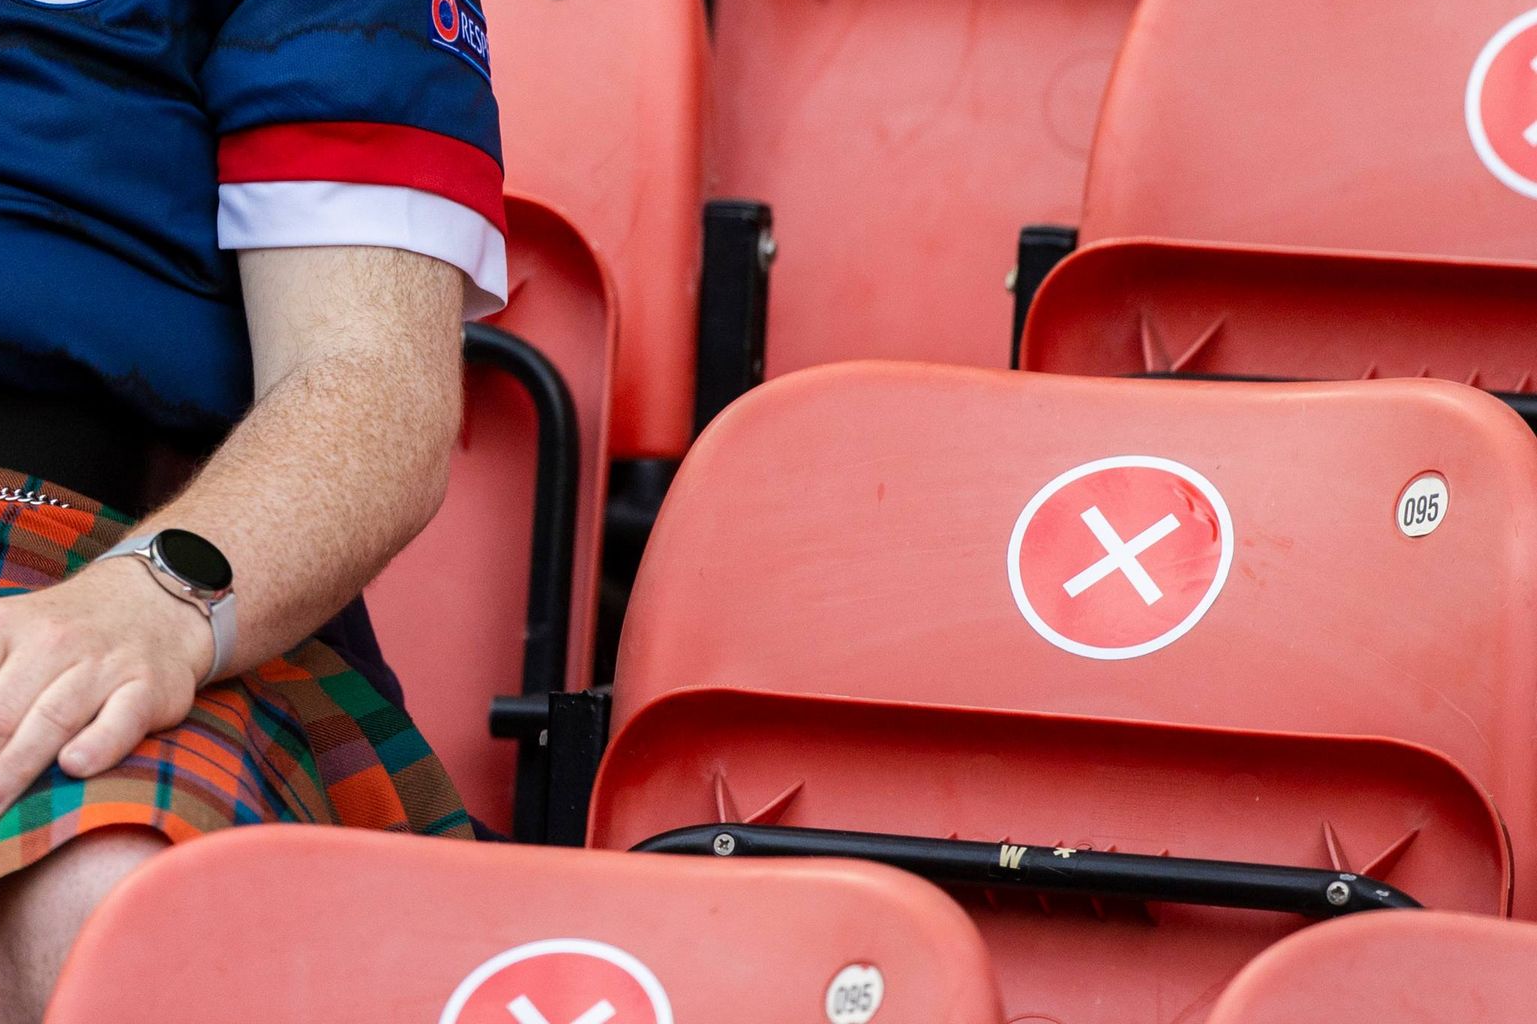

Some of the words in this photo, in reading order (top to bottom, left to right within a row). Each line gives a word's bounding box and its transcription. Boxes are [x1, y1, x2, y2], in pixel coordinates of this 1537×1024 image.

[461, 11, 491, 67] RESP
[1403, 493, 1440, 527] 095
[999, 844, 1027, 870] W
[834, 983, 873, 1015] 095
